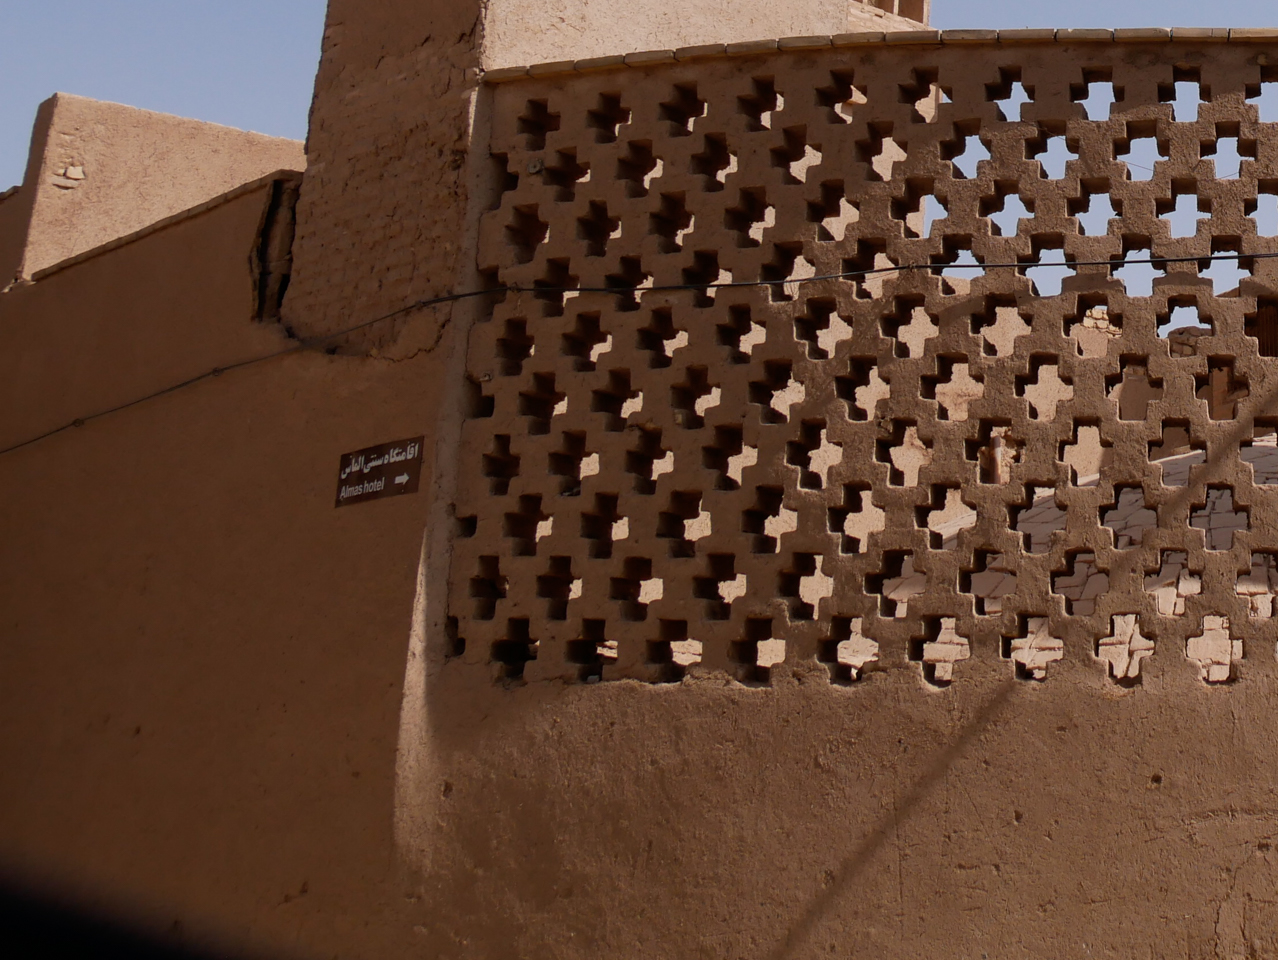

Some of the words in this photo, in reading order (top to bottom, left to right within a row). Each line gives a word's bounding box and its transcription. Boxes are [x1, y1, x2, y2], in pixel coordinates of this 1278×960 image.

[363, 454, 384, 473] سنتی
[384, 443, 419, 464] اقامتگاه
[341, 455, 365, 480] الماس
[340, 484, 363, 499] Almas
[363, 477, 385, 493] hotel
